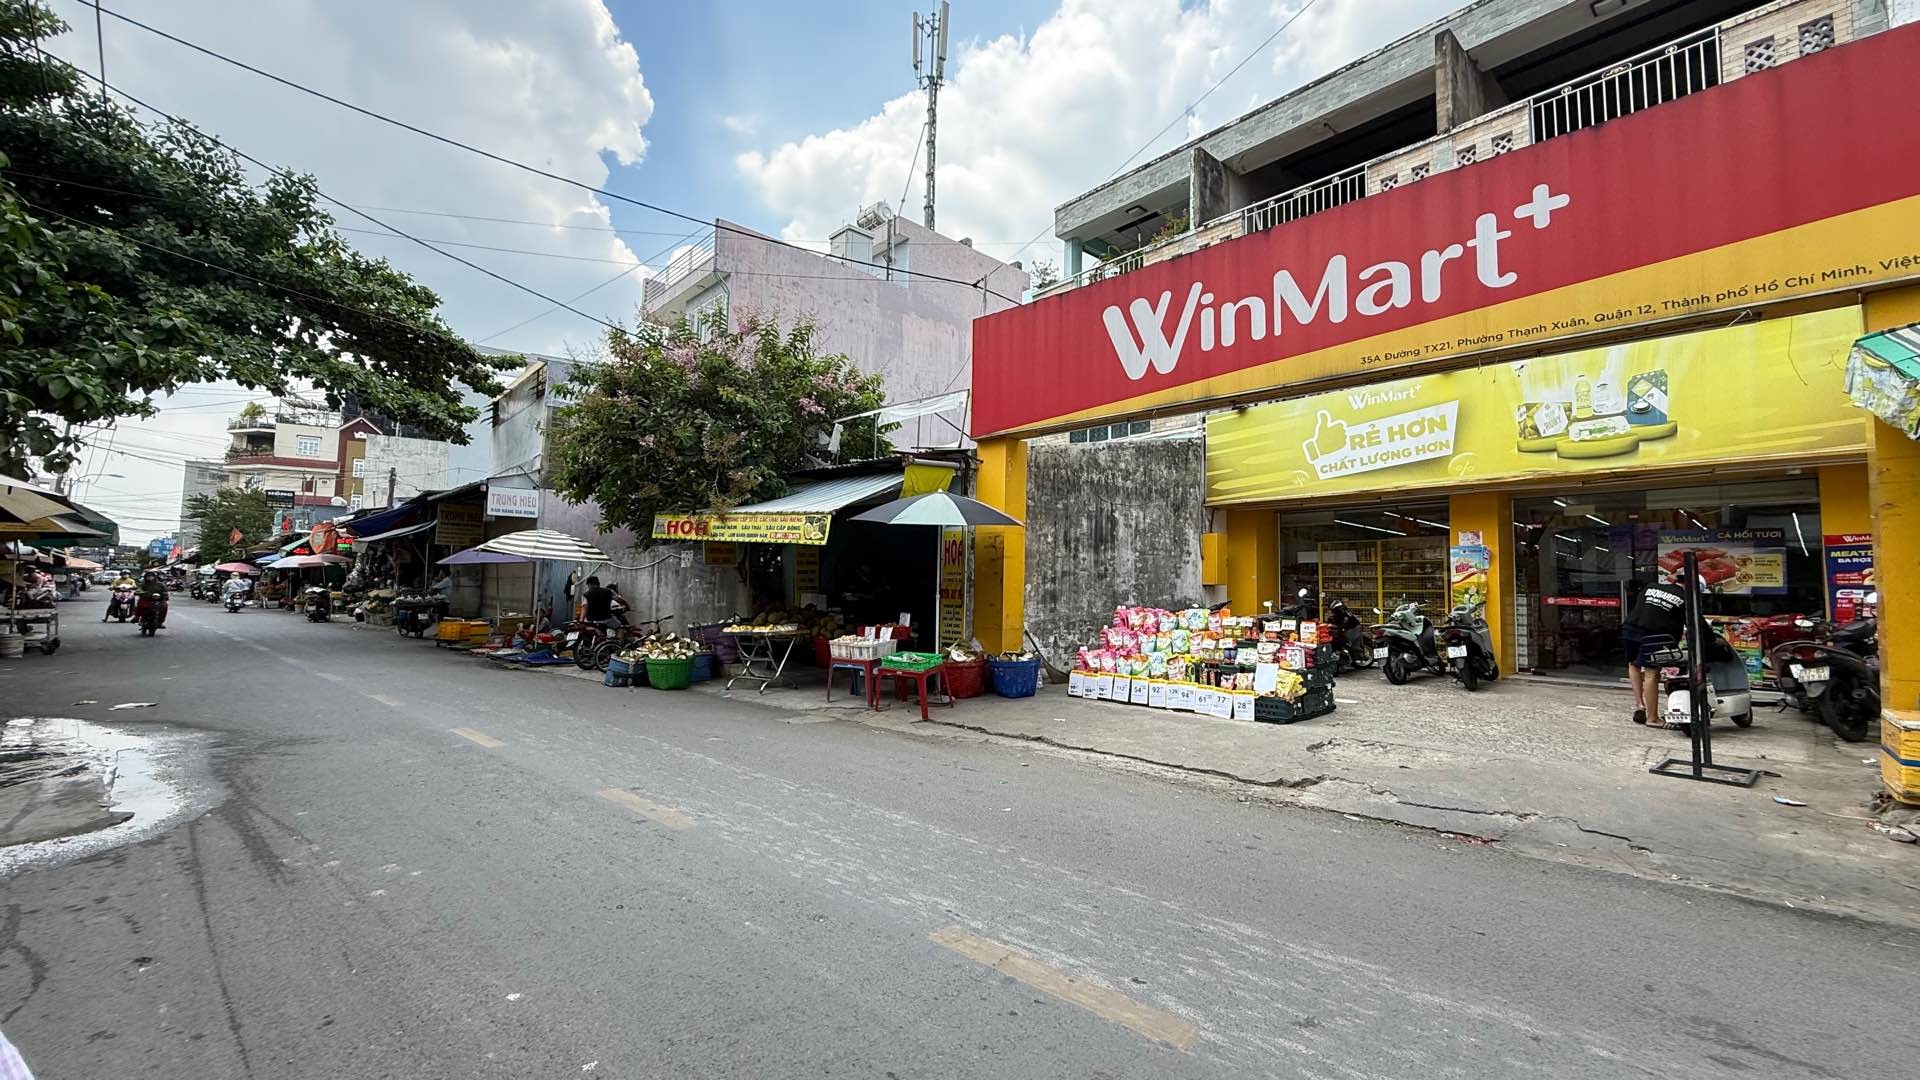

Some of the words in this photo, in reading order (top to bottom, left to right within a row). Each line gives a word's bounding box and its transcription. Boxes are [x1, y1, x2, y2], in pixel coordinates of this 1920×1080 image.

[1102, 183, 1570, 381] WinMart+
[1360, 354, 1381, 365] 35A
[1384, 348, 1421, 361] Đường
[1424, 341, 1454, 353] TX21,
[1457, 333, 1504, 347] Phường
[1507, 324, 1547, 338] Thạnh
[1551, 317, 1590, 331] Xuân,
[1594, 309, 1633, 323] Quận
[1637, 304, 1656, 315] 12,
[1662, 294, 1711, 310] Thành
[1716, 284, 1749, 303] phố
[1755, 280, 1779, 294] Hồ
[1785, 274, 1815, 289] Chí
[1821, 264, 1873, 281] Minh,
[1879, 255, 1920, 271] Việt
[1348, 384, 1422, 411] WinMart+
[1350, 423, 1382, 450] RẺ
[1387, 414, 1448, 442] HƠN
[1320, 455, 1357, 474] CHẤT
[1360, 447, 1412, 467] LƯỢNG
[1415, 439, 1451, 456] HƠN
[492, 493, 517, 506] TRUNG
